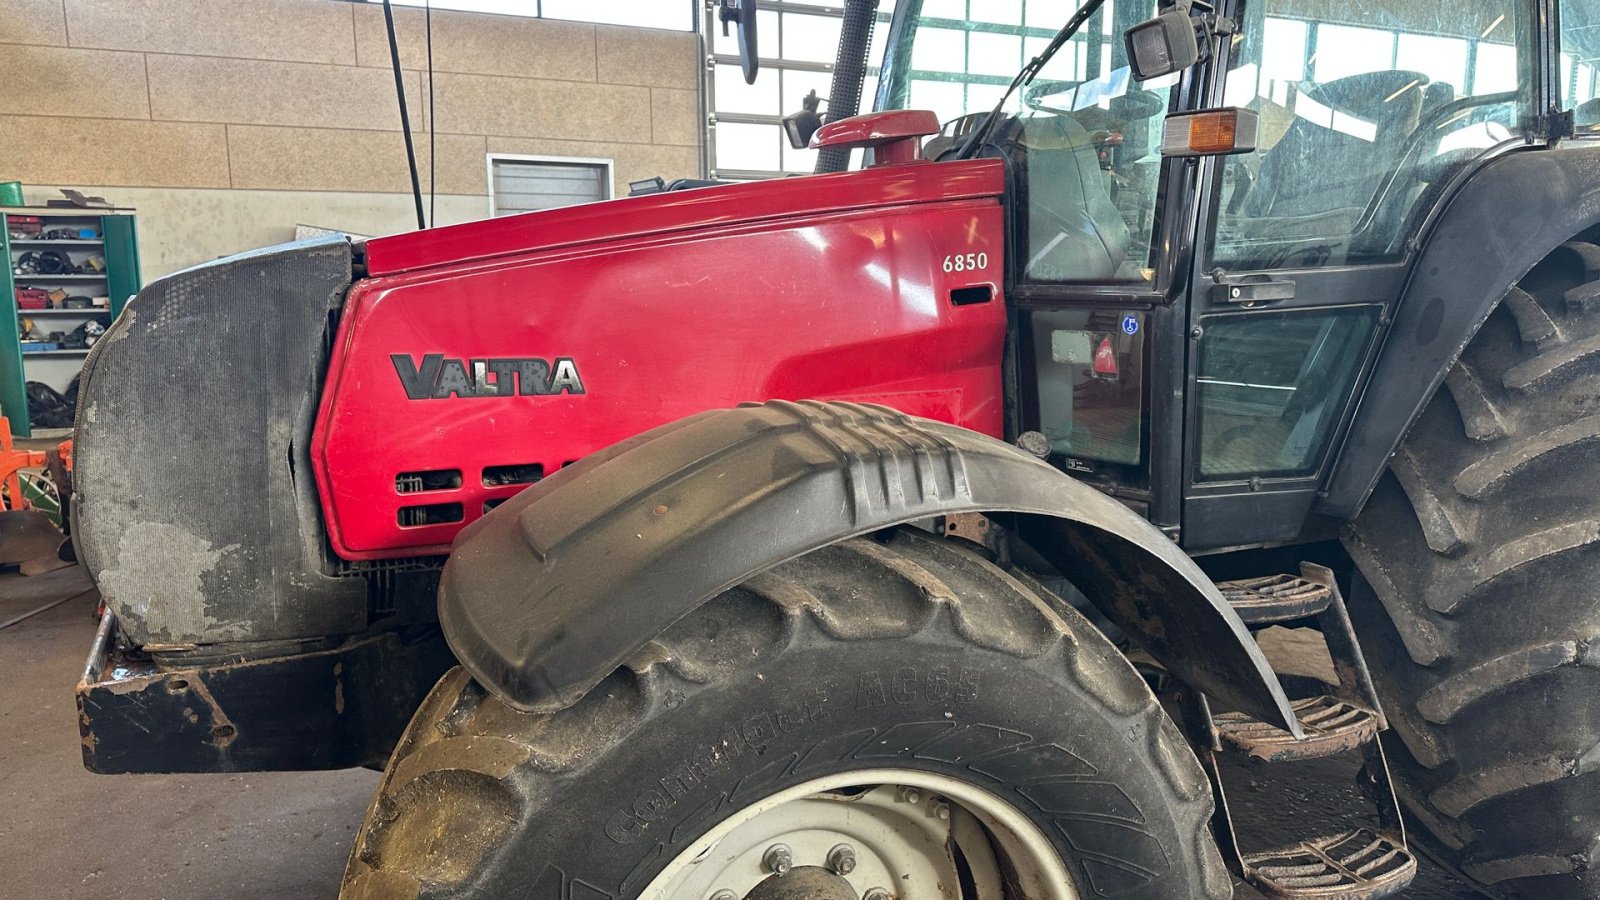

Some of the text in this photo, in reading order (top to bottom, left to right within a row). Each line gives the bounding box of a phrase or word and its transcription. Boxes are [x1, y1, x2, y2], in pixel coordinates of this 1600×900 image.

[942, 252, 988, 273] 6850
[390, 354, 586, 400] VALTRA
[855, 665, 980, 709] AC65
